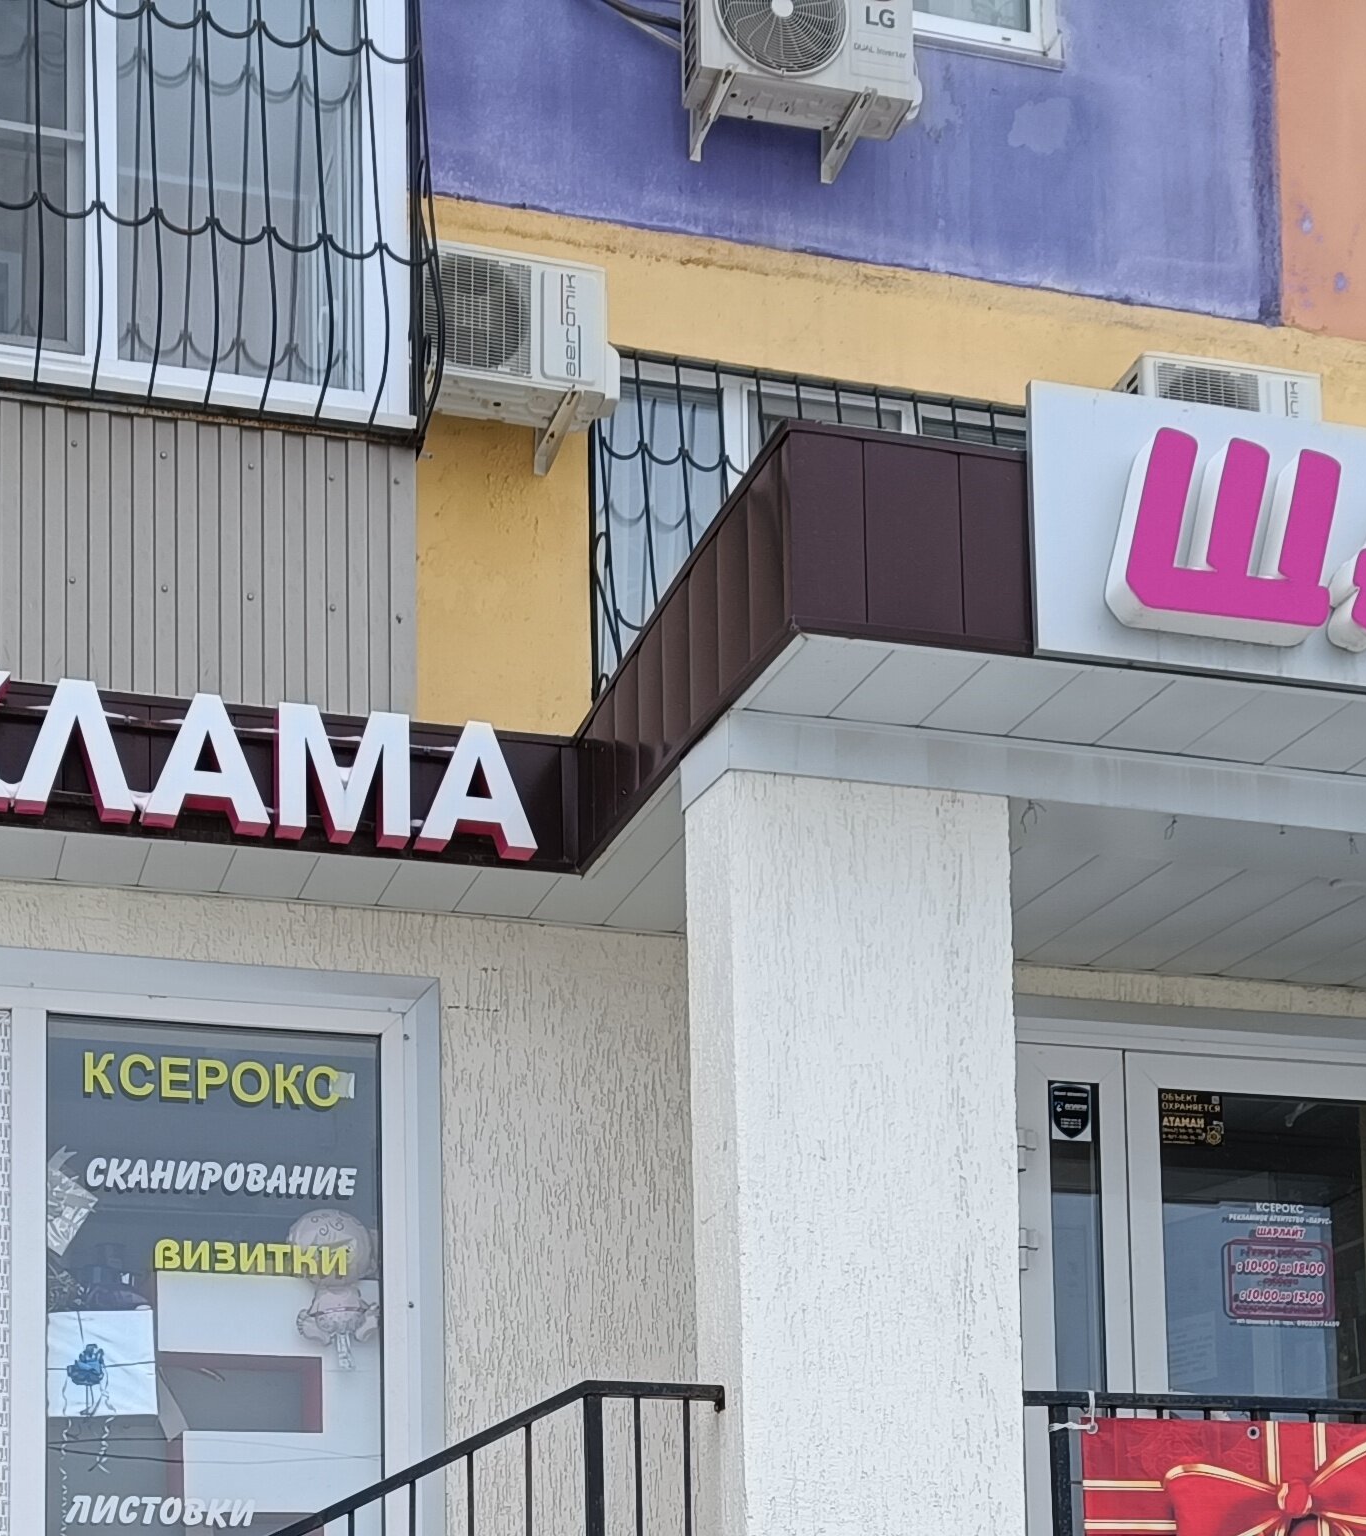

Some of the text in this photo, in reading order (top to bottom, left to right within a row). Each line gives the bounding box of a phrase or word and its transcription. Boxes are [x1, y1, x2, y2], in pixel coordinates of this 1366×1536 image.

[865, 5, 895, 29] LG
[853, 42, 875, 54] DUAL
[564, 273, 578, 377] aeronik
[1161, 1092, 1198, 1103] ОБЪЕКТ
[1161, 1102, 1221, 1113] ОХРАНЯЕТСЯ
[1162, 1116, 1205, 1128] АТАМАН
[85, 1157, 357, 1198] СКАНИРОВАНИЕ
[1255, 1202, 1305, 1215] КСЕРОКС
[1256, 1226, 1305, 1239] ШАРЛАЙТ
[65, 1495, 255, 1529] ЛИСТОВКИ
